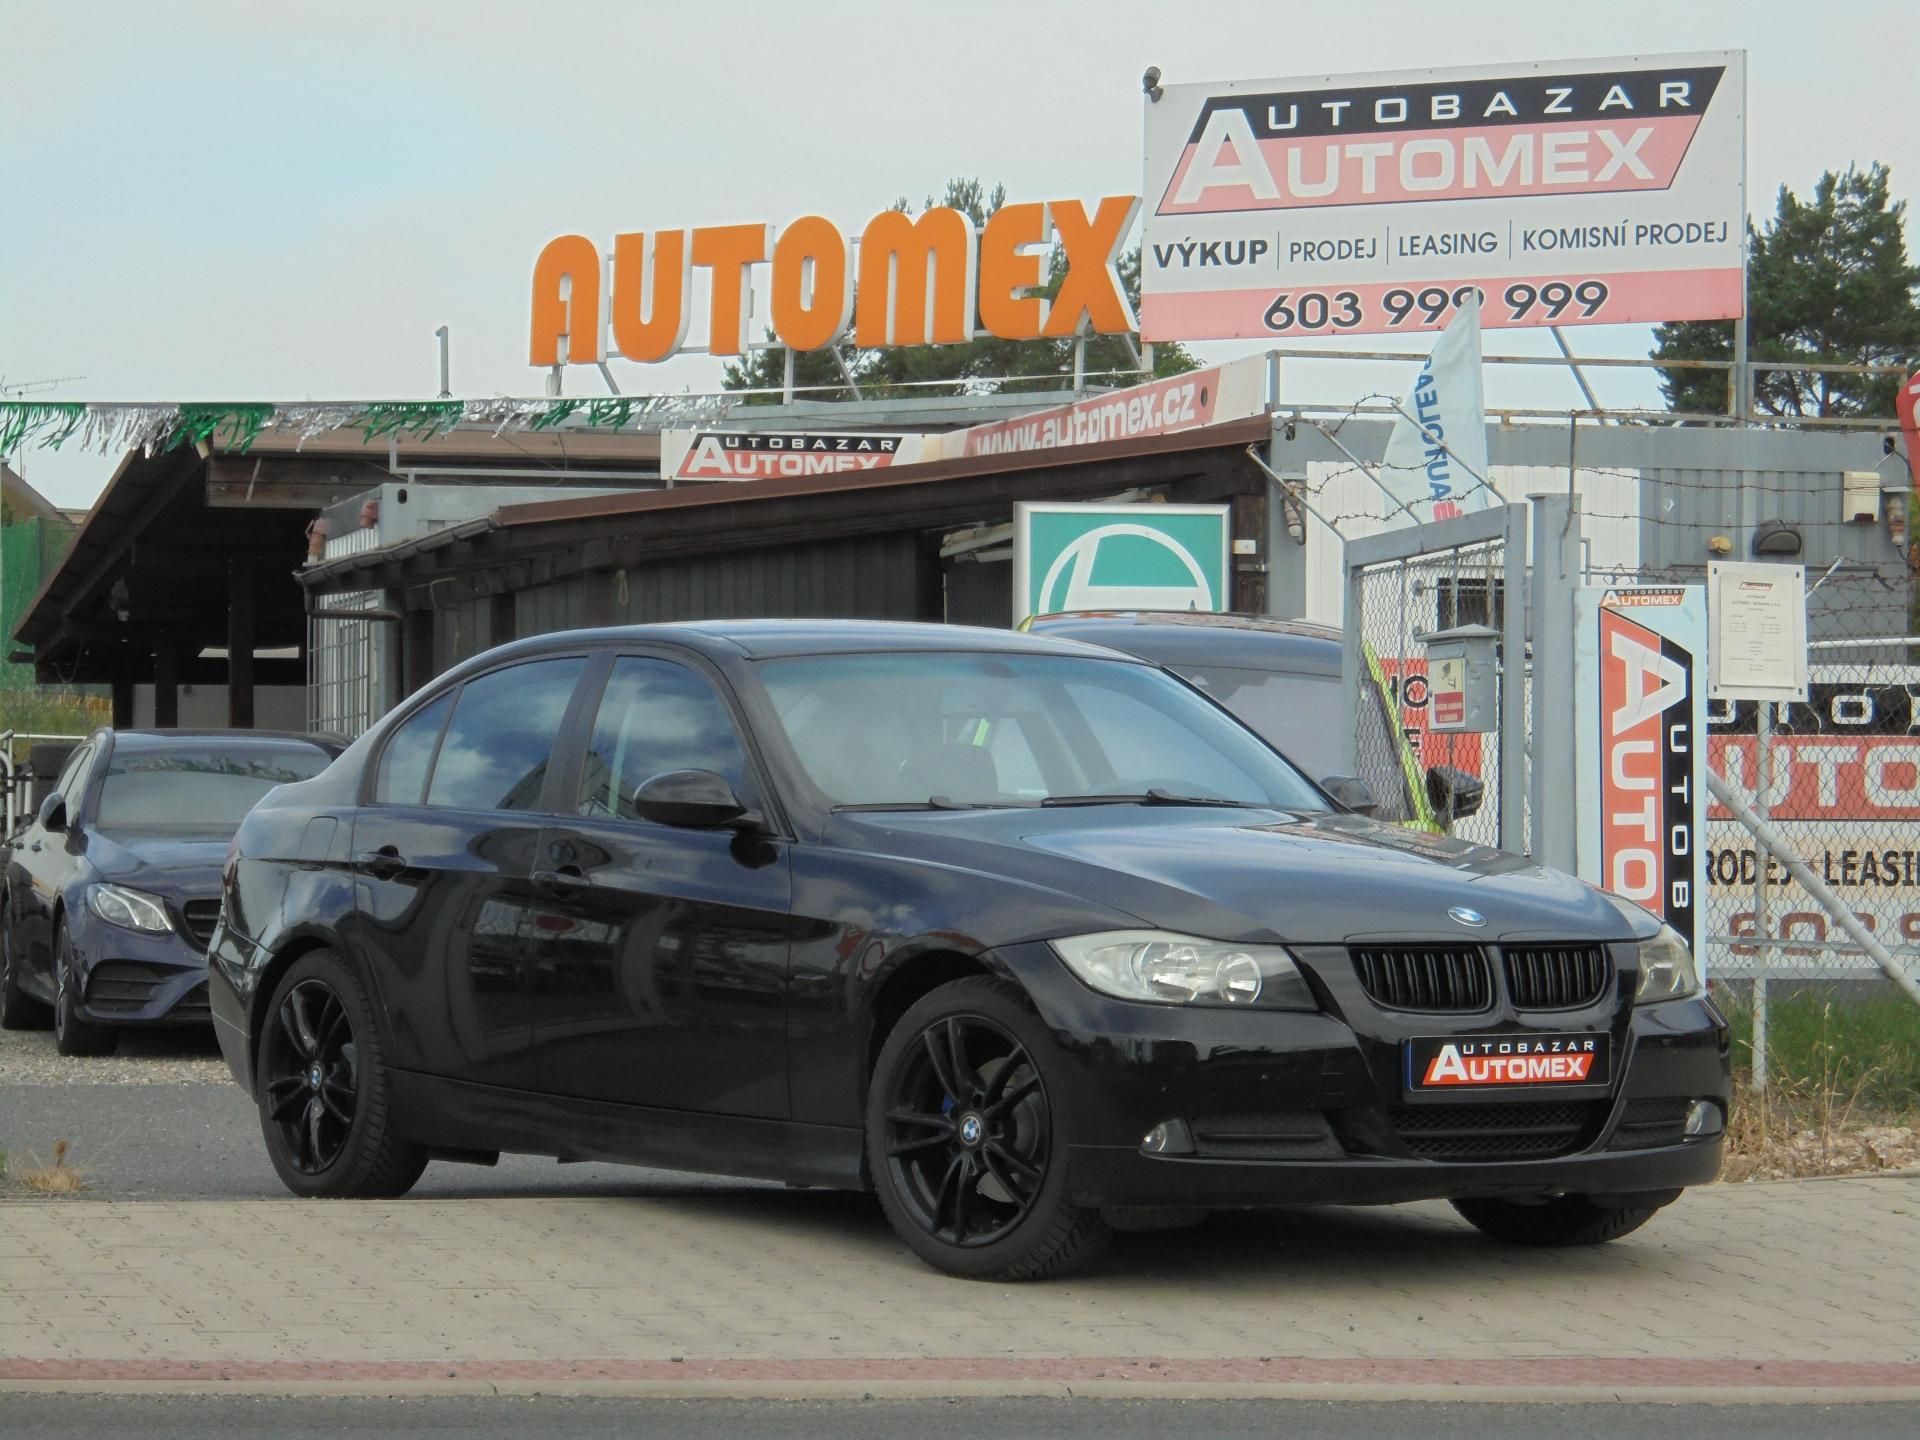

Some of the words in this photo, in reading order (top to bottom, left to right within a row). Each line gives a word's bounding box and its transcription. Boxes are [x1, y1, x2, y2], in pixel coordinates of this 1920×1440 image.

[1172, 107, 1656, 205] AUTOMEX
[1153, 236, 1269, 268] VÝKUP
[1290, 237, 1377, 262] PRODEJ
[1399, 231, 1499, 257] LEASING
[1523, 219, 1629, 251] KOMISNÍ
[1635, 221, 1728, 246] PRODEJ
[529, 194, 1140, 366] AUTOMEX
[1263, 291, 1363, 331] 603
[1504, 280, 1609, 320] 999
[976, 382, 1196, 455] www.automex.cz
[1601, 590, 1680, 606] AUTOMEX
[1611, 631, 1687, 906] AUTO
[1824, 850, 1920, 886] LEASI
[1429, 1044, 1584, 1082] AUTOMEX
